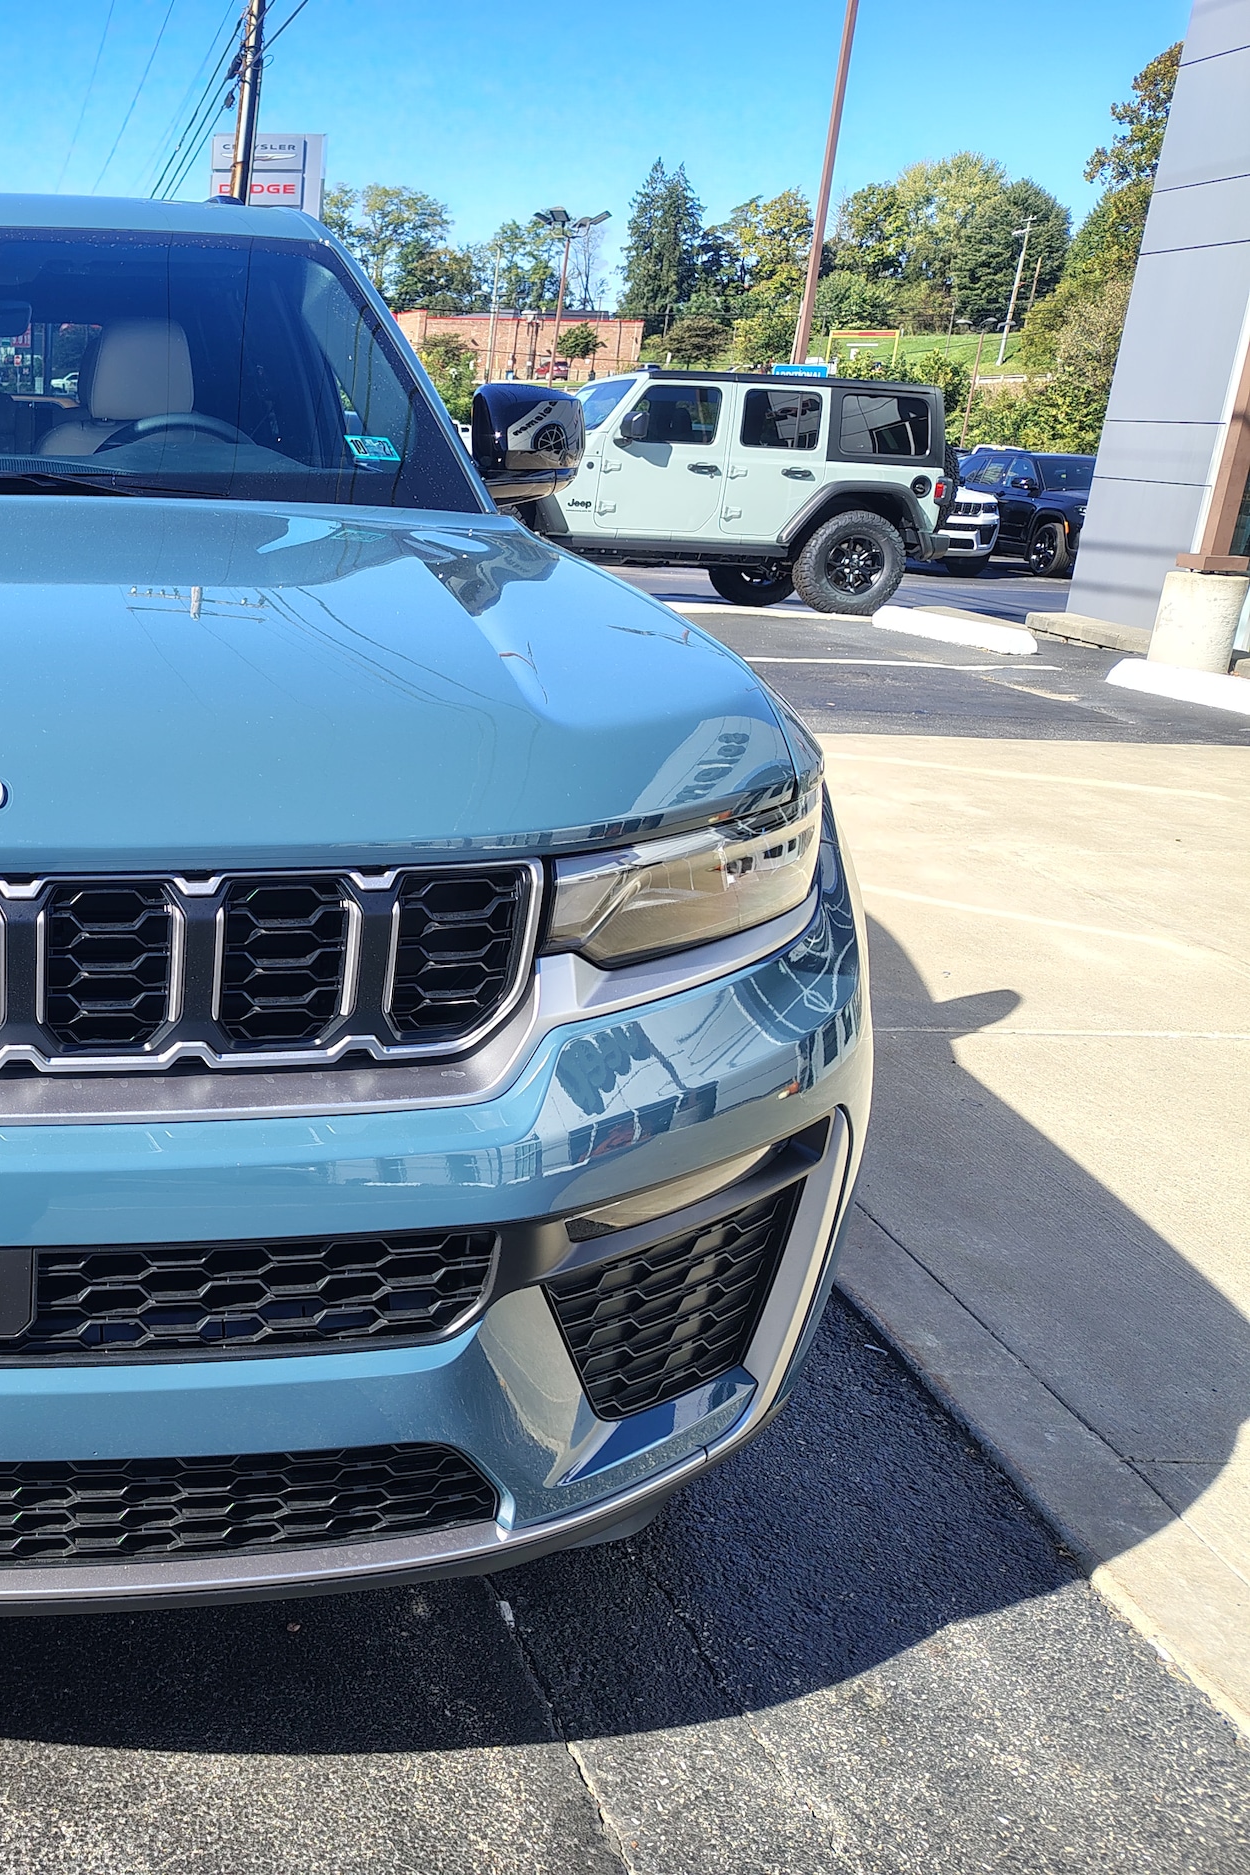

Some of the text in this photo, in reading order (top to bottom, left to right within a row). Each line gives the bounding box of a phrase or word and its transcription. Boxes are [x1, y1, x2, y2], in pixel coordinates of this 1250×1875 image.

[222, 143, 296, 151] CYSLER
[219, 184, 296, 194] DDGE
[567, 498, 592, 509] Jeep
